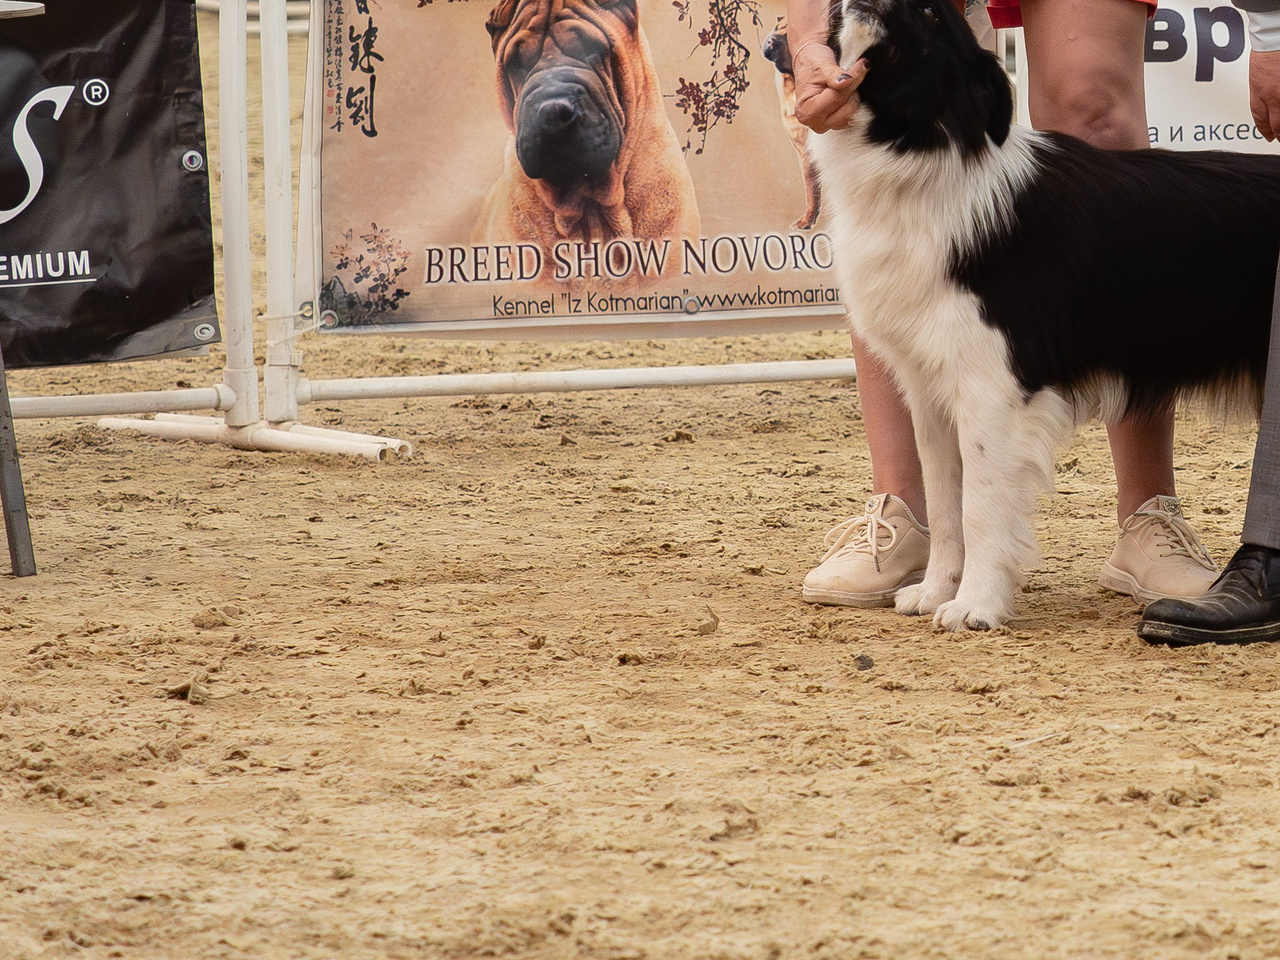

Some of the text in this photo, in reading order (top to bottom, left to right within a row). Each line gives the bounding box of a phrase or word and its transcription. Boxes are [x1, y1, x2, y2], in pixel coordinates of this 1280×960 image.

[424, 244, 542, 284] BREED
[553, 239, 671, 280] SHOW
[492, 293, 555, 316] Kennel
